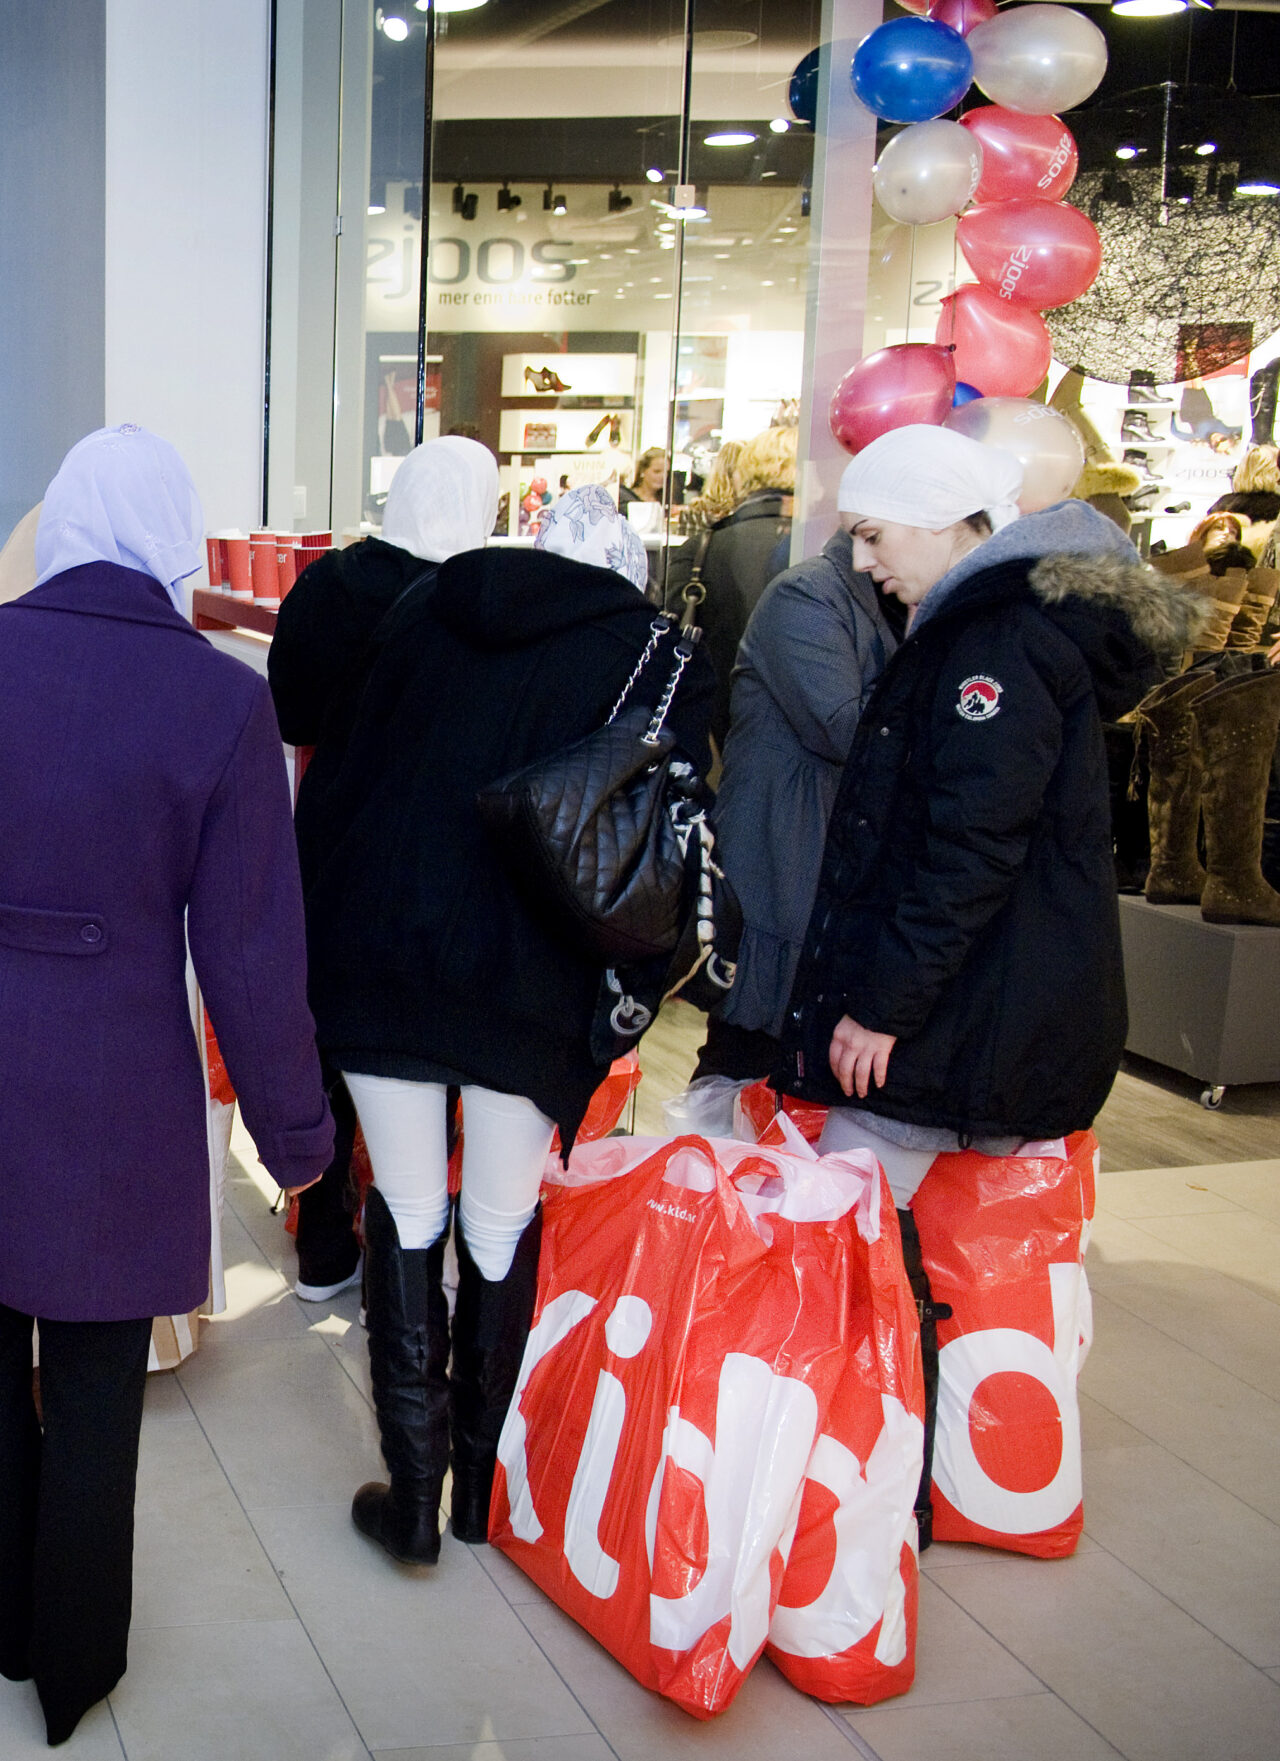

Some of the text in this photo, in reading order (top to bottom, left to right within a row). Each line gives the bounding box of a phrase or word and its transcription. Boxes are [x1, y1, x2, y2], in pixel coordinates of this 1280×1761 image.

[999, 244, 1032, 300] zjoos
[438, 288, 594, 306] mer enn bre føtter
